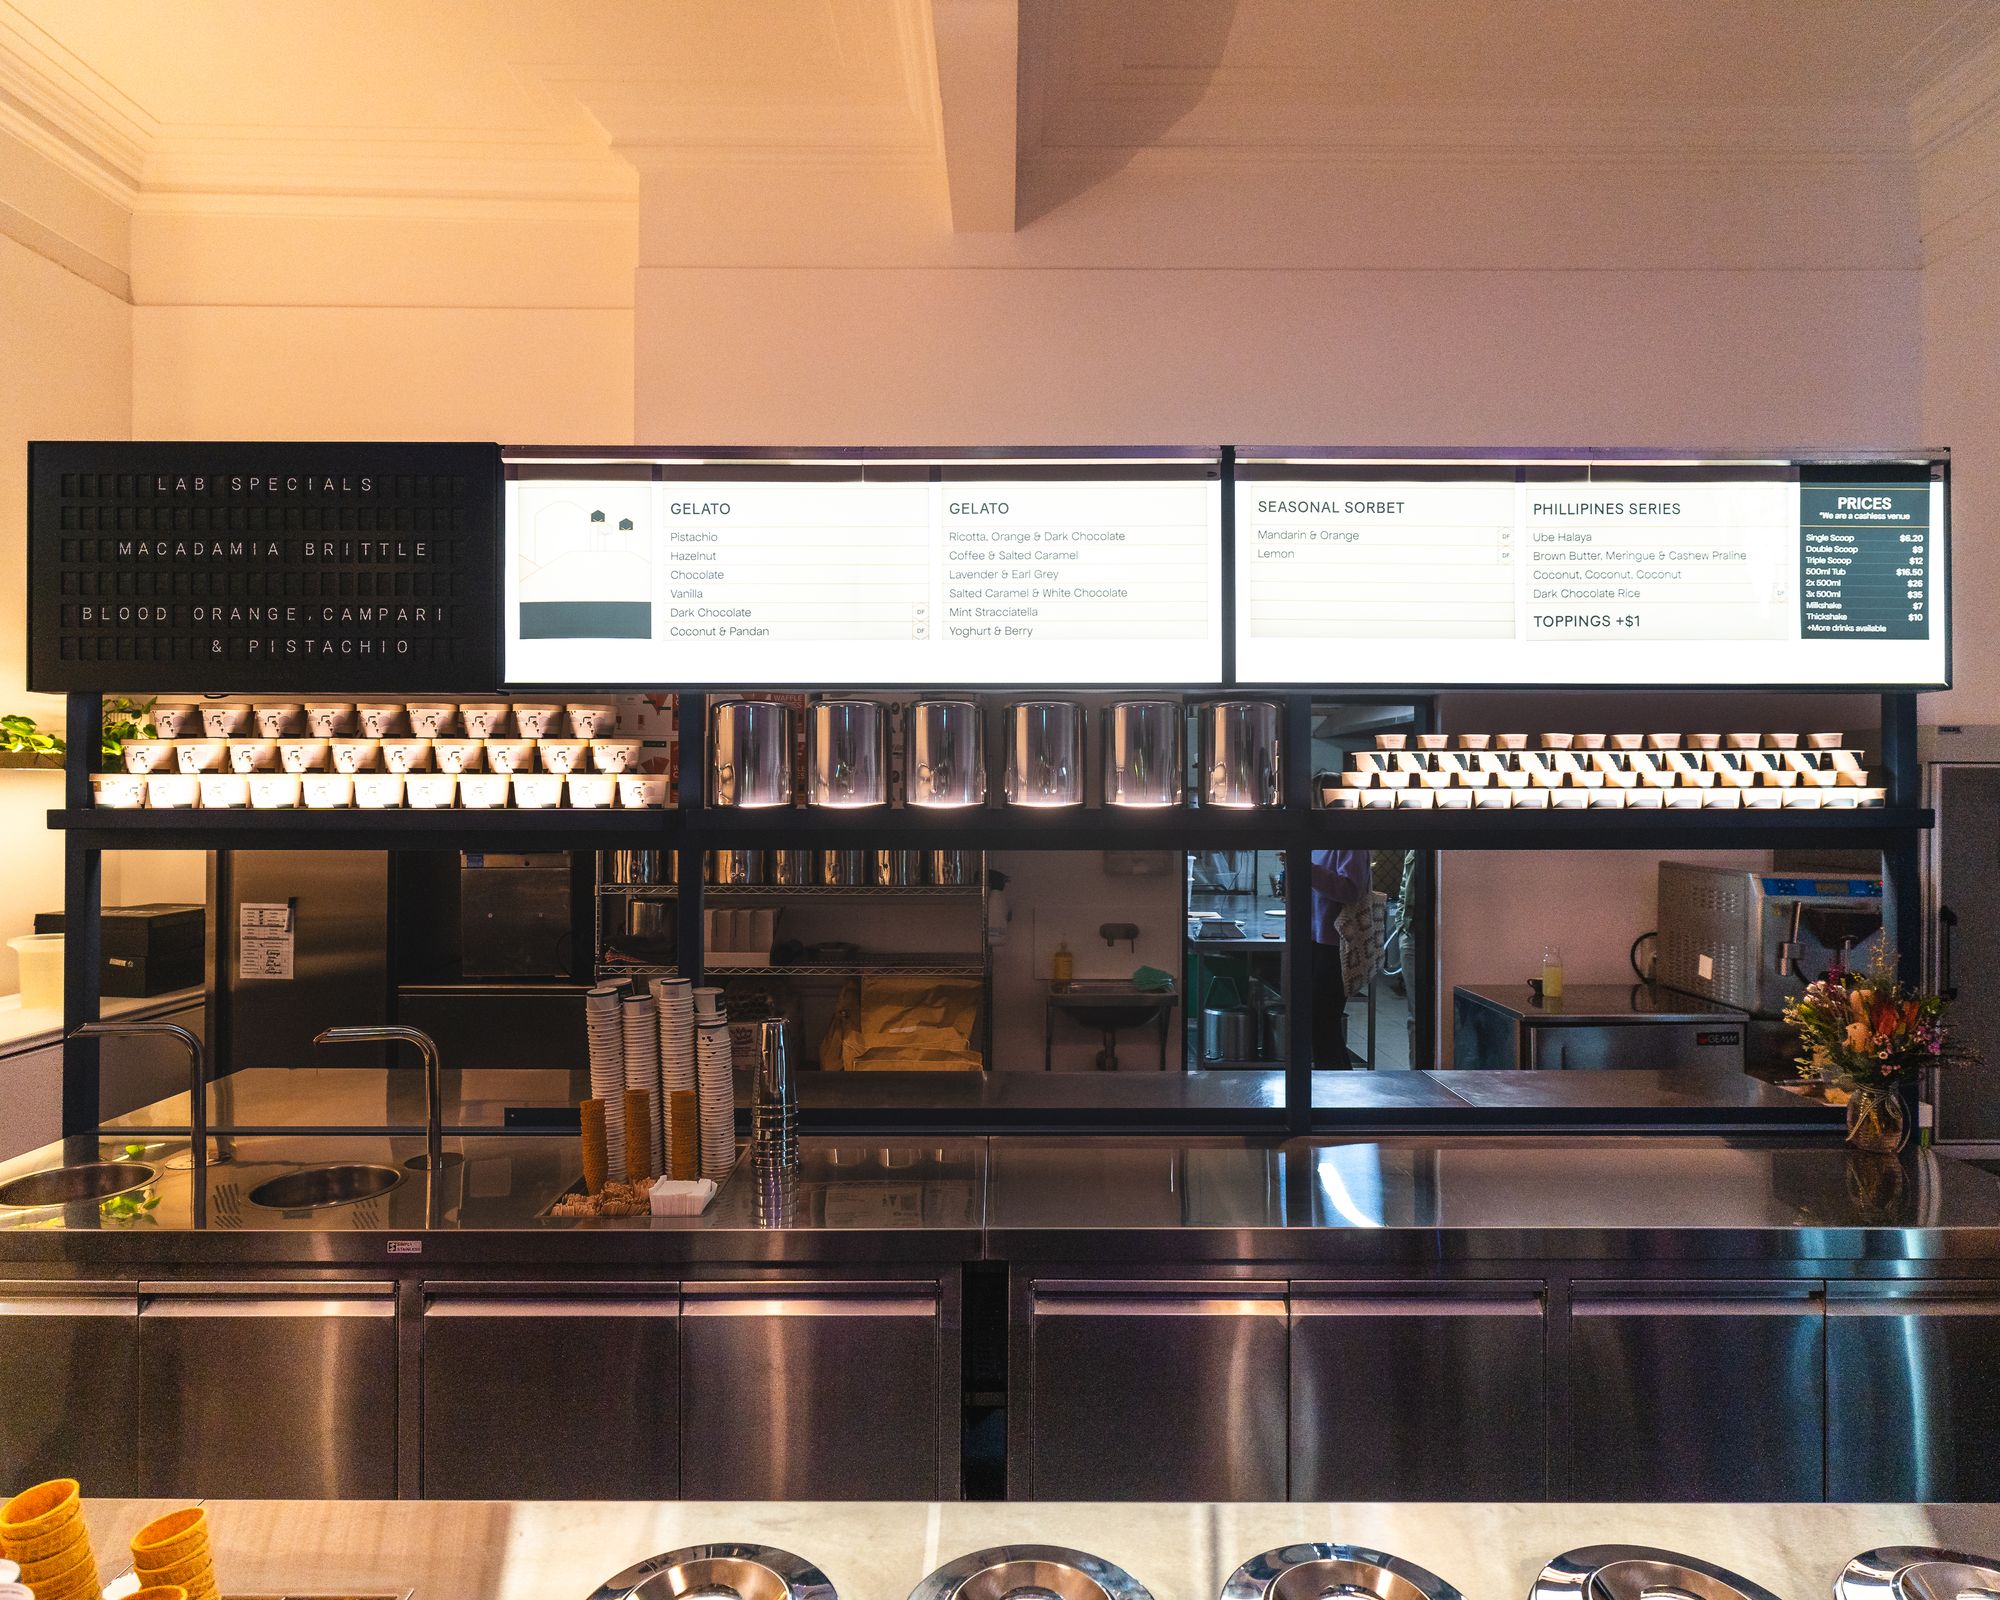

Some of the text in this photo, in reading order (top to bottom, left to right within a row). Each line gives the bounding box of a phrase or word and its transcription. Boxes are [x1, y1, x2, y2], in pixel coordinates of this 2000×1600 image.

[159, 478, 373, 491] LAB SPECIALS
[671, 503, 730, 514] GELATO
[950, 503, 1009, 514] GELATO
[1258, 501, 1404, 513] SEASONAL SORBET
[1838, 497, 1891, 510] PRICES
[1534, 503, 1680, 515] PHILLIPINES SERIES
[671, 532, 718, 542] Pistachio
[950, 532, 1125, 543] Ricotta, Orange & Dark Chocolate
[1258, 530, 1359, 542] Mandarin & Orange
[1533, 533, 1591, 544] Ube Halaya
[1806, 534, 1828, 543] Single
[1830, 534, 1854, 543] Scoop
[120, 542, 425, 555] MACADAMIA BRITTLE
[1834, 546, 1858, 554] Scoop
[1912, 546, 1923, 554] $9
[671, 552, 716, 560] Hazelnut
[949, 551, 1078, 560] Coffee & Salted Caramel
[1258, 550, 1294, 558] Lemon
[1534, 551, 1746, 562] Brown Butter, Meringue & Cashew Praline
[1806, 557, 1923, 565] Triple Scoop $12
[671, 570, 724, 579] Chocolate
[950, 570, 1058, 581] Lavender & Earl Grey
[1533, 570, 1681, 580] Coconut, Coconut, Coconut
[671, 589, 703, 598] Vanilla
[949, 588, 1127, 598] Salted Caramel & White Chocolate
[1534, 589, 1640, 598] Dark Chocolate Rice
[1907, 591, 1923, 599] $35
[1913, 602, 1923, 610] $7
[83, 607, 166, 620] BLOOD
[671, 608, 751, 617] Dark Chocolate
[950, 608, 1038, 616] Mint Stracciatella
[1908, 613, 1923, 621] $10
[1534, 615, 1639, 628] TOPPINGS +$1
[671, 627, 769, 636] Coconut & Pandan
[950, 626, 1033, 638] Yoghurt & Berry
[212, 640, 407, 653] & PISTACHIO
[774, 693, 803, 701] WAFFLE
